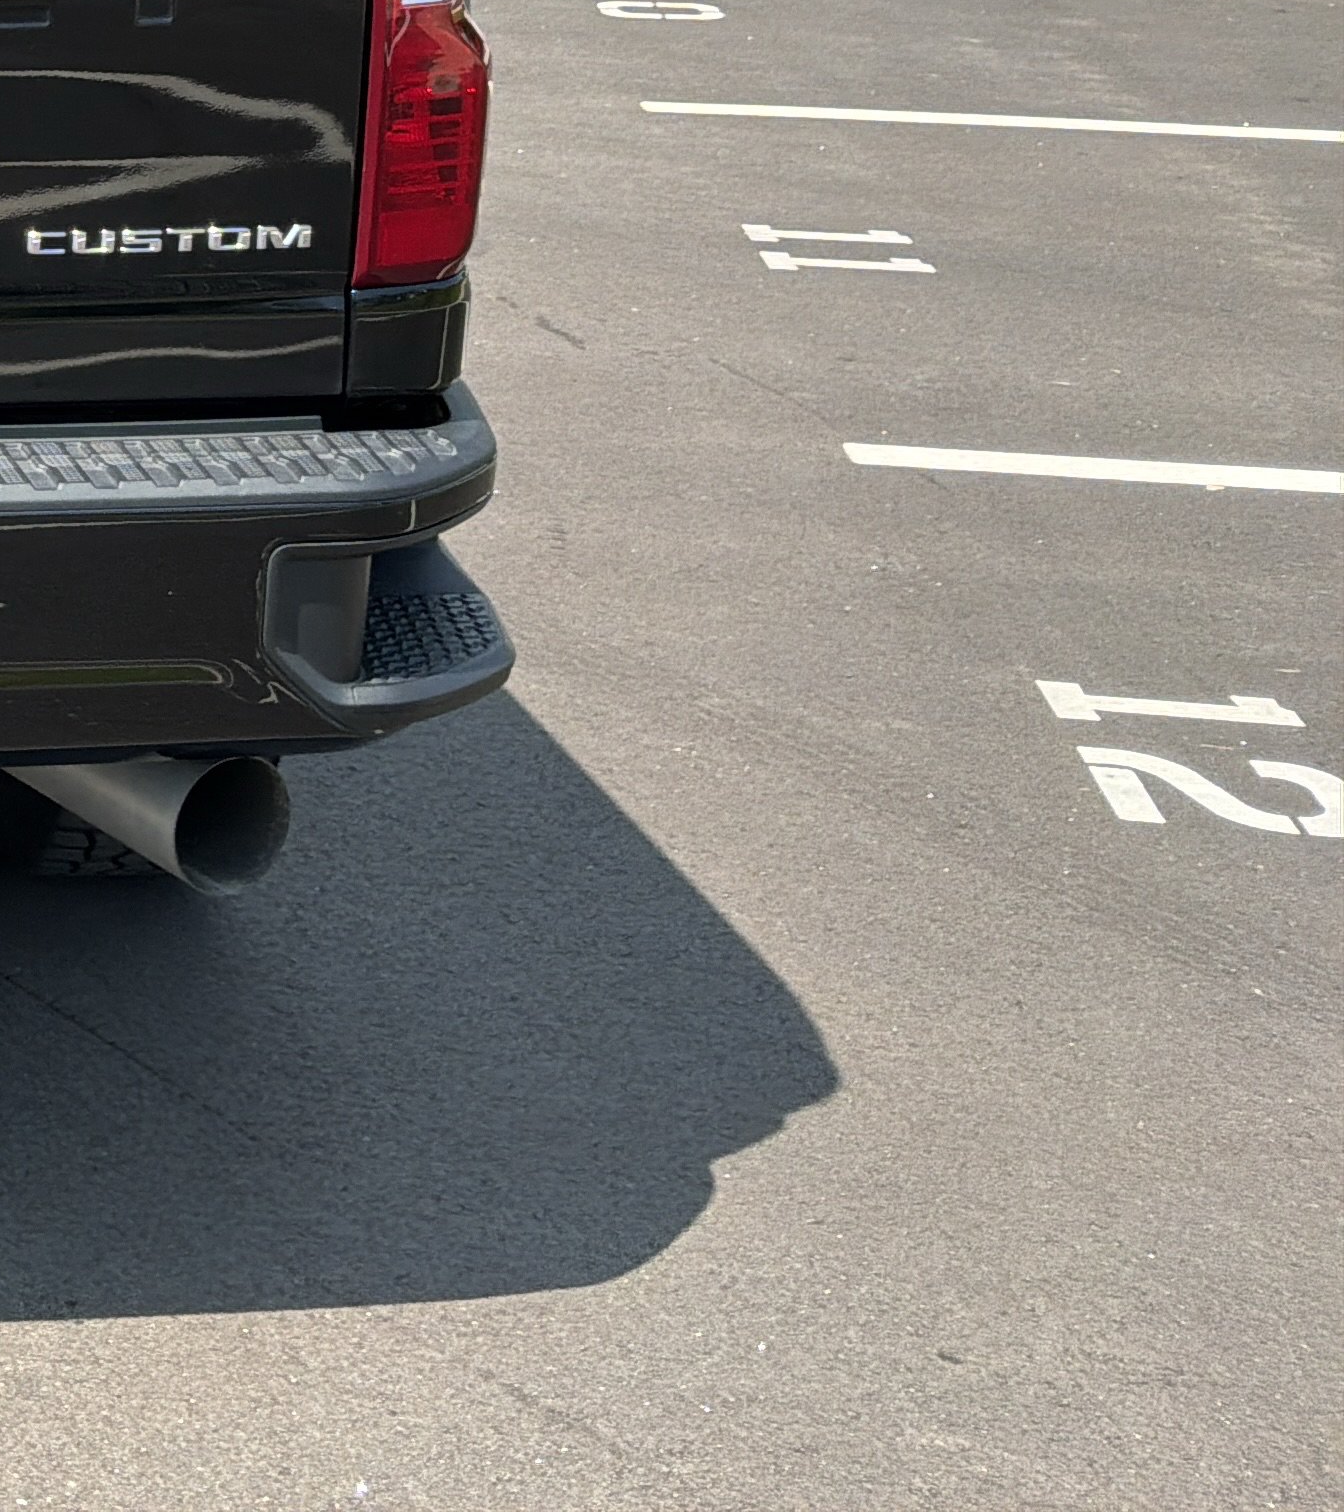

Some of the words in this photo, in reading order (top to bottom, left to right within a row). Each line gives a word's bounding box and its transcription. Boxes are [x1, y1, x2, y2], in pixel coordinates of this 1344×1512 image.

[25, 223, 313, 256] CUSTOM
[741, 223, 936, 274] 11
[1034, 679, 1344, 838] 12
